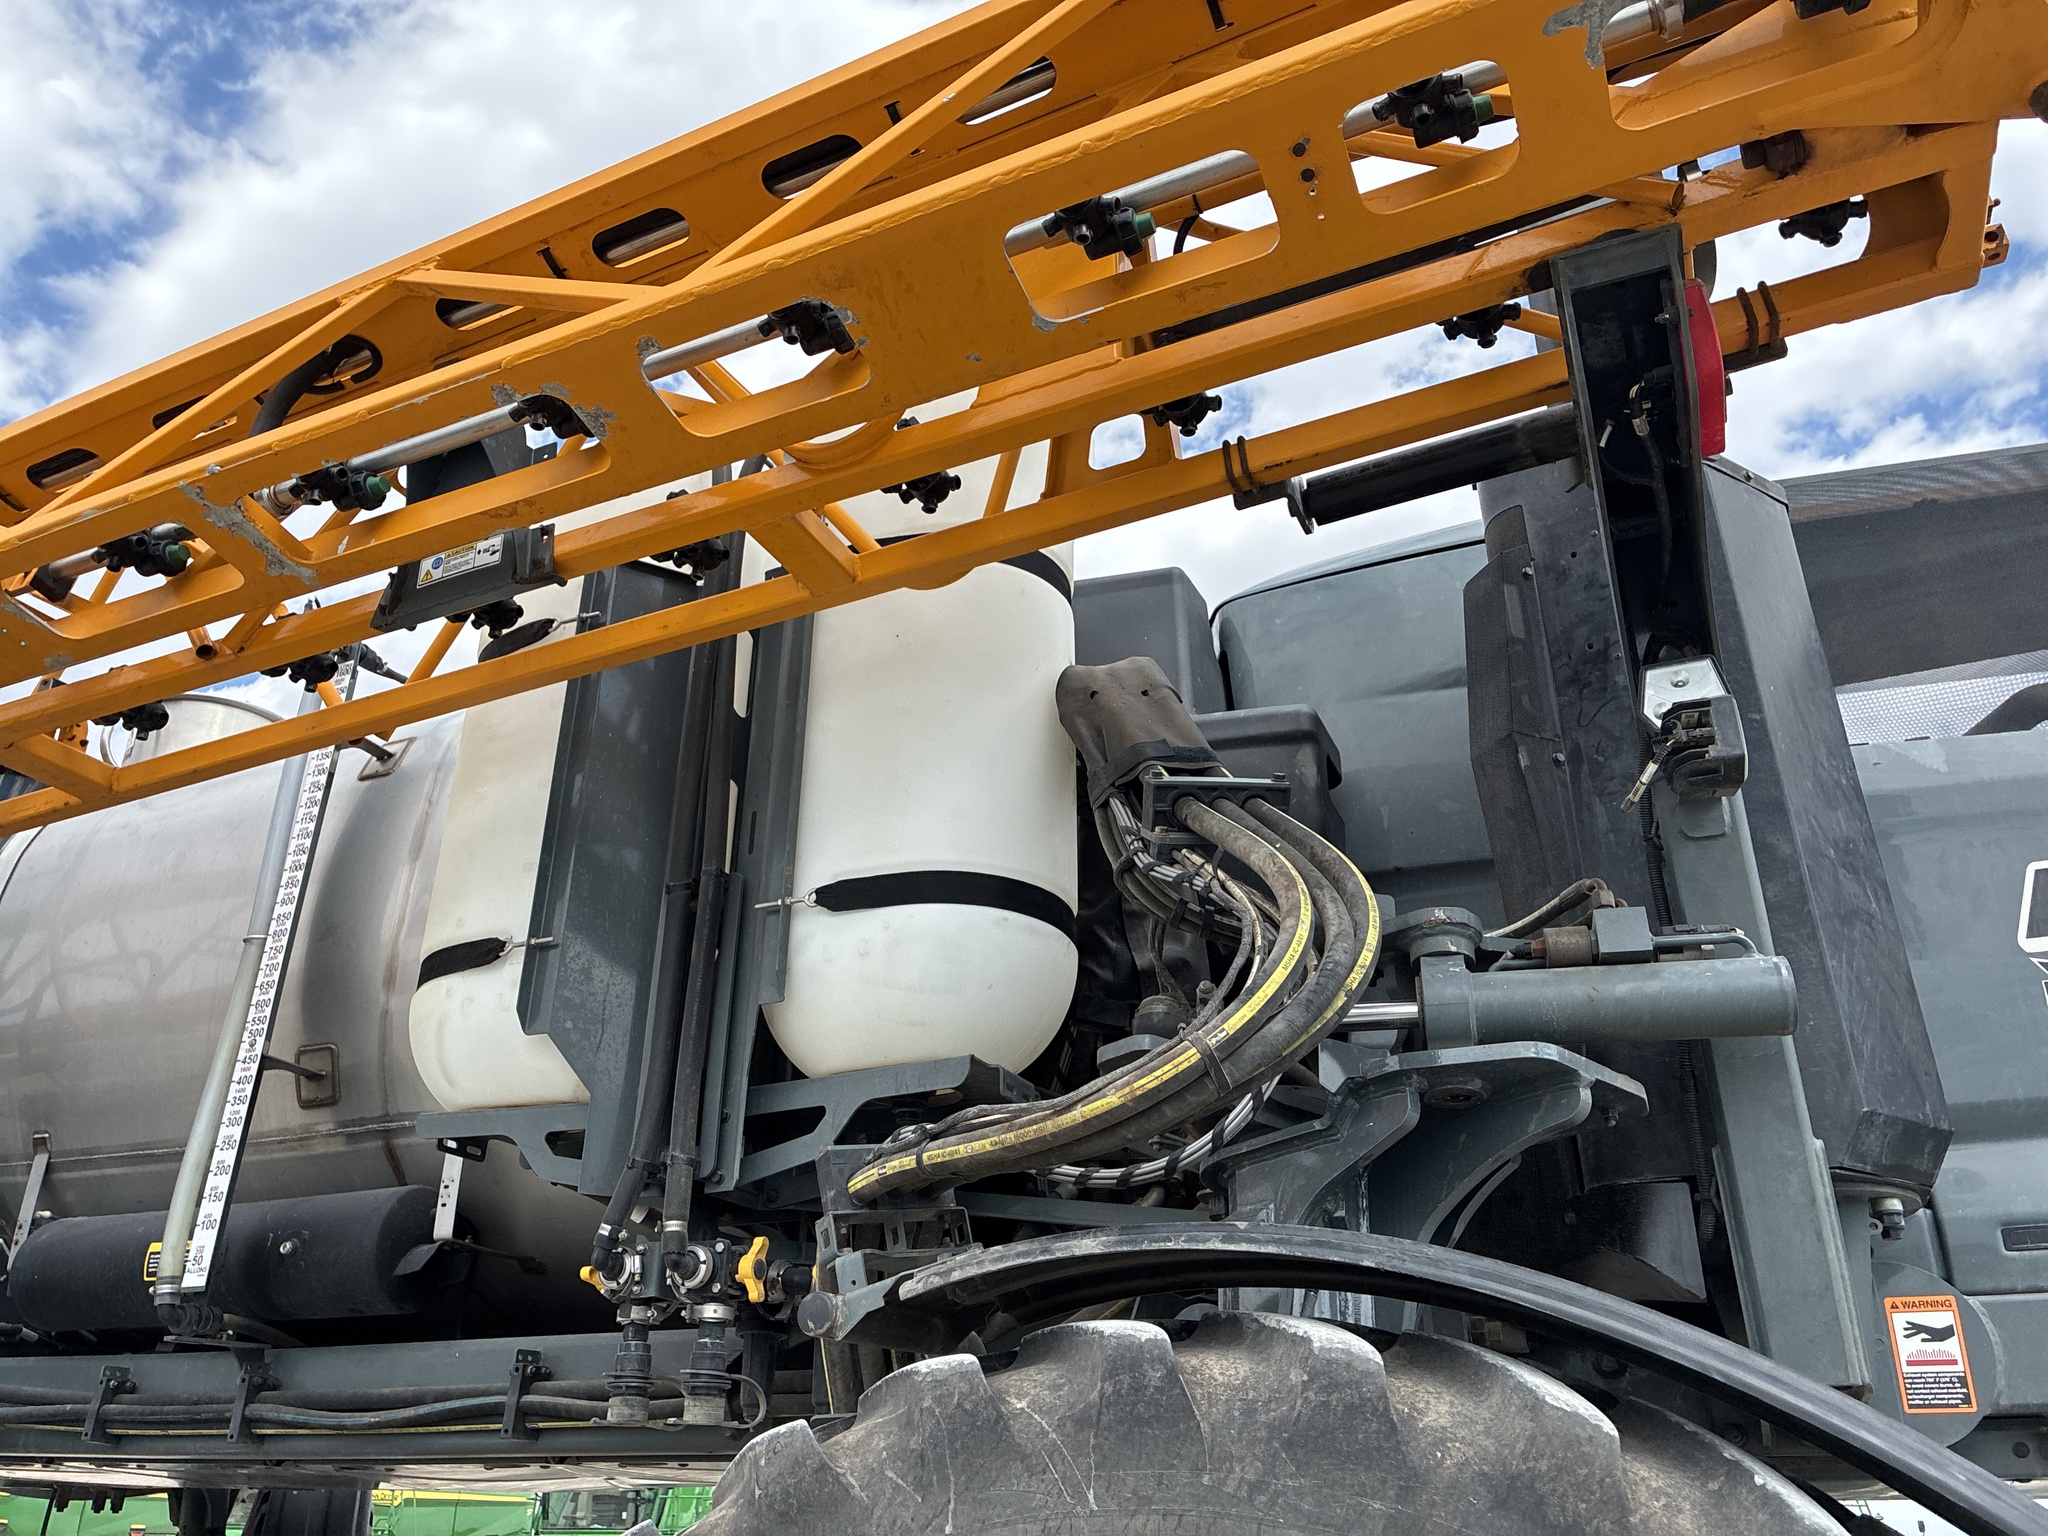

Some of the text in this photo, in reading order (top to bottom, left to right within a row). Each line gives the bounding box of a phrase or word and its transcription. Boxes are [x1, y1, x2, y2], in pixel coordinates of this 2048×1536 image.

[316, 751, 332, 762] 1350
[312, 767, 328, 777] 1300
[308, 783, 324, 794] 1250
[304, 799, 320, 810] 1200
[300, 815, 316, 825] 1150
[297, 830, 312, 841] 1100
[293, 846, 309, 857] 1050
[289, 862, 305, 874] 1000
[284, 879, 300, 890] 950
[280, 896, 296, 907] 900
[276, 911, 292, 922] 850
[272, 928, 288, 939] 800
[268, 945, 284, 956] 750
[1282, 952, 1296, 971] MSHA
[264, 962, 280, 974] 700
[260, 980, 275, 992] 650
[255, 998, 271, 1010] 600
[250, 1015, 267, 1026] 550
[248, 1027, 264, 1039] 500
[241, 1054, 258, 1065] 450
[236, 1074, 253, 1086] 400
[230, 1095, 248, 1106] 350
[226, 1116, 243, 1128] 300
[220, 1140, 237, 1151] 250
[213, 1164, 231, 1176] 200
[208, 1191, 224, 1203] 150
[201, 1219, 217, 1231] 100
[192, 1255, 203, 1266] 50
[1901, 1300, 1952, 1309] WARNING
